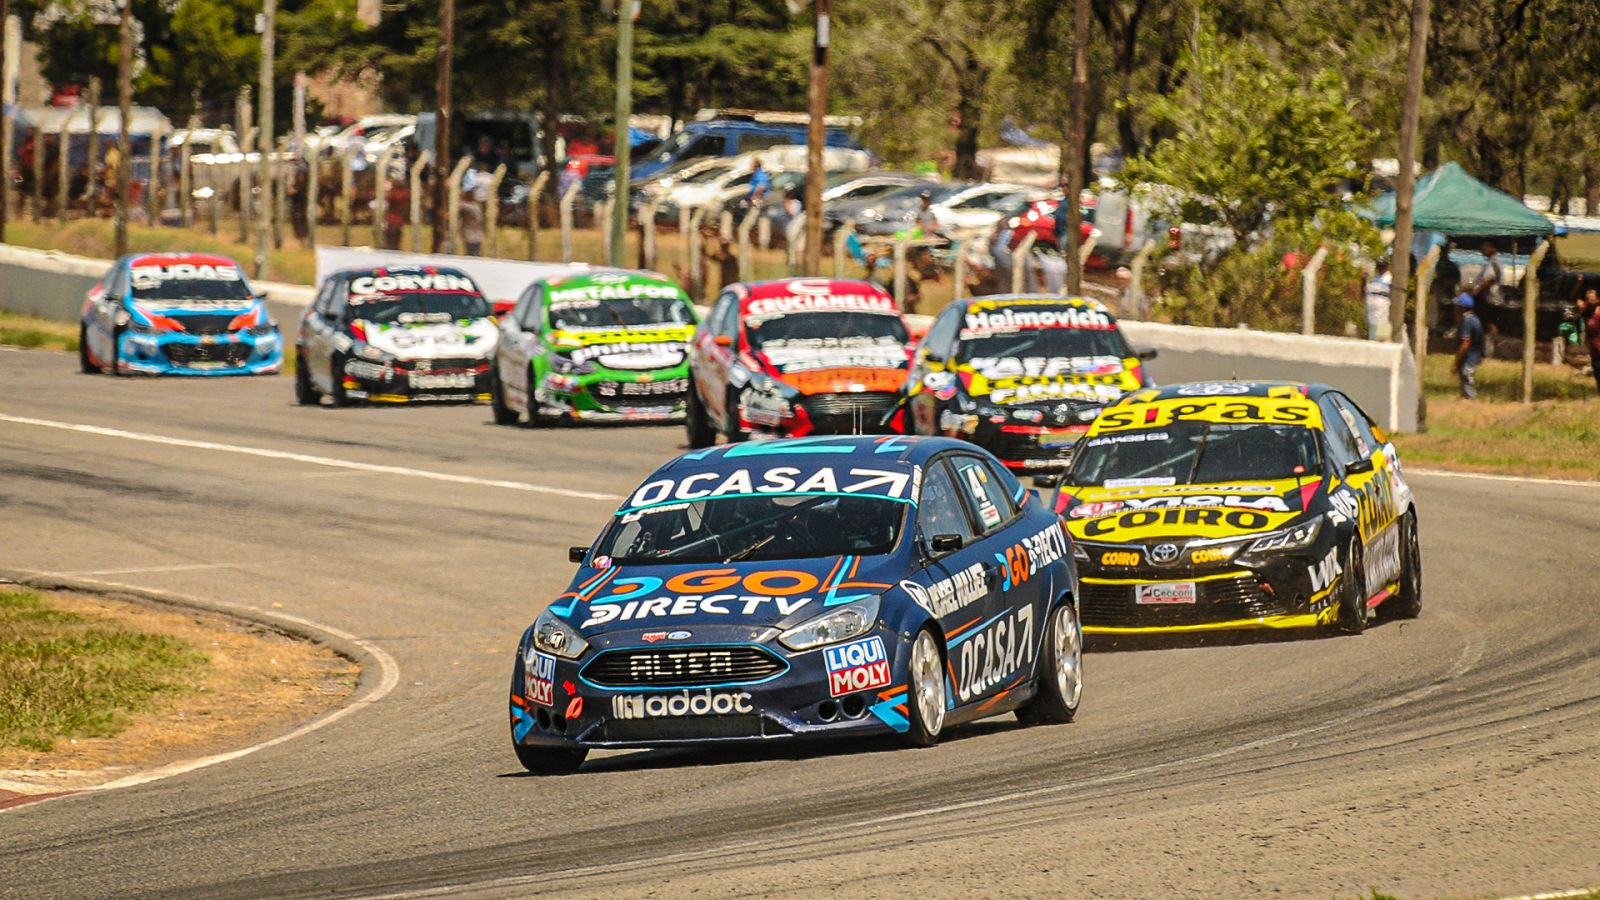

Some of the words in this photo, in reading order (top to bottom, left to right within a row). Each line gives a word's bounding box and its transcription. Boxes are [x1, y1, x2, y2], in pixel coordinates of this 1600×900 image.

[351, 275, 475, 294] CORVEN
[550, 285, 679, 301] METALFOR
[965, 308, 1110, 329] Haimovich
[629, 467, 838, 508] OCASA
[966, 467, 987, 502] 4
[1125, 495, 1291, 512] VIOLA
[1083, 509, 1269, 537] COIRO
[1101, 552, 1140, 566] COIRO
[1307, 546, 1343, 592] WIX
[1153, 589, 1193, 598] Cecconi
[580, 595, 812, 629] DIRECTV
[828, 640, 884, 671] LIQUI
[959, 615, 1016, 702] OCASA
[833, 662, 887, 694] MOLY
[645, 688, 754, 717] addoc
